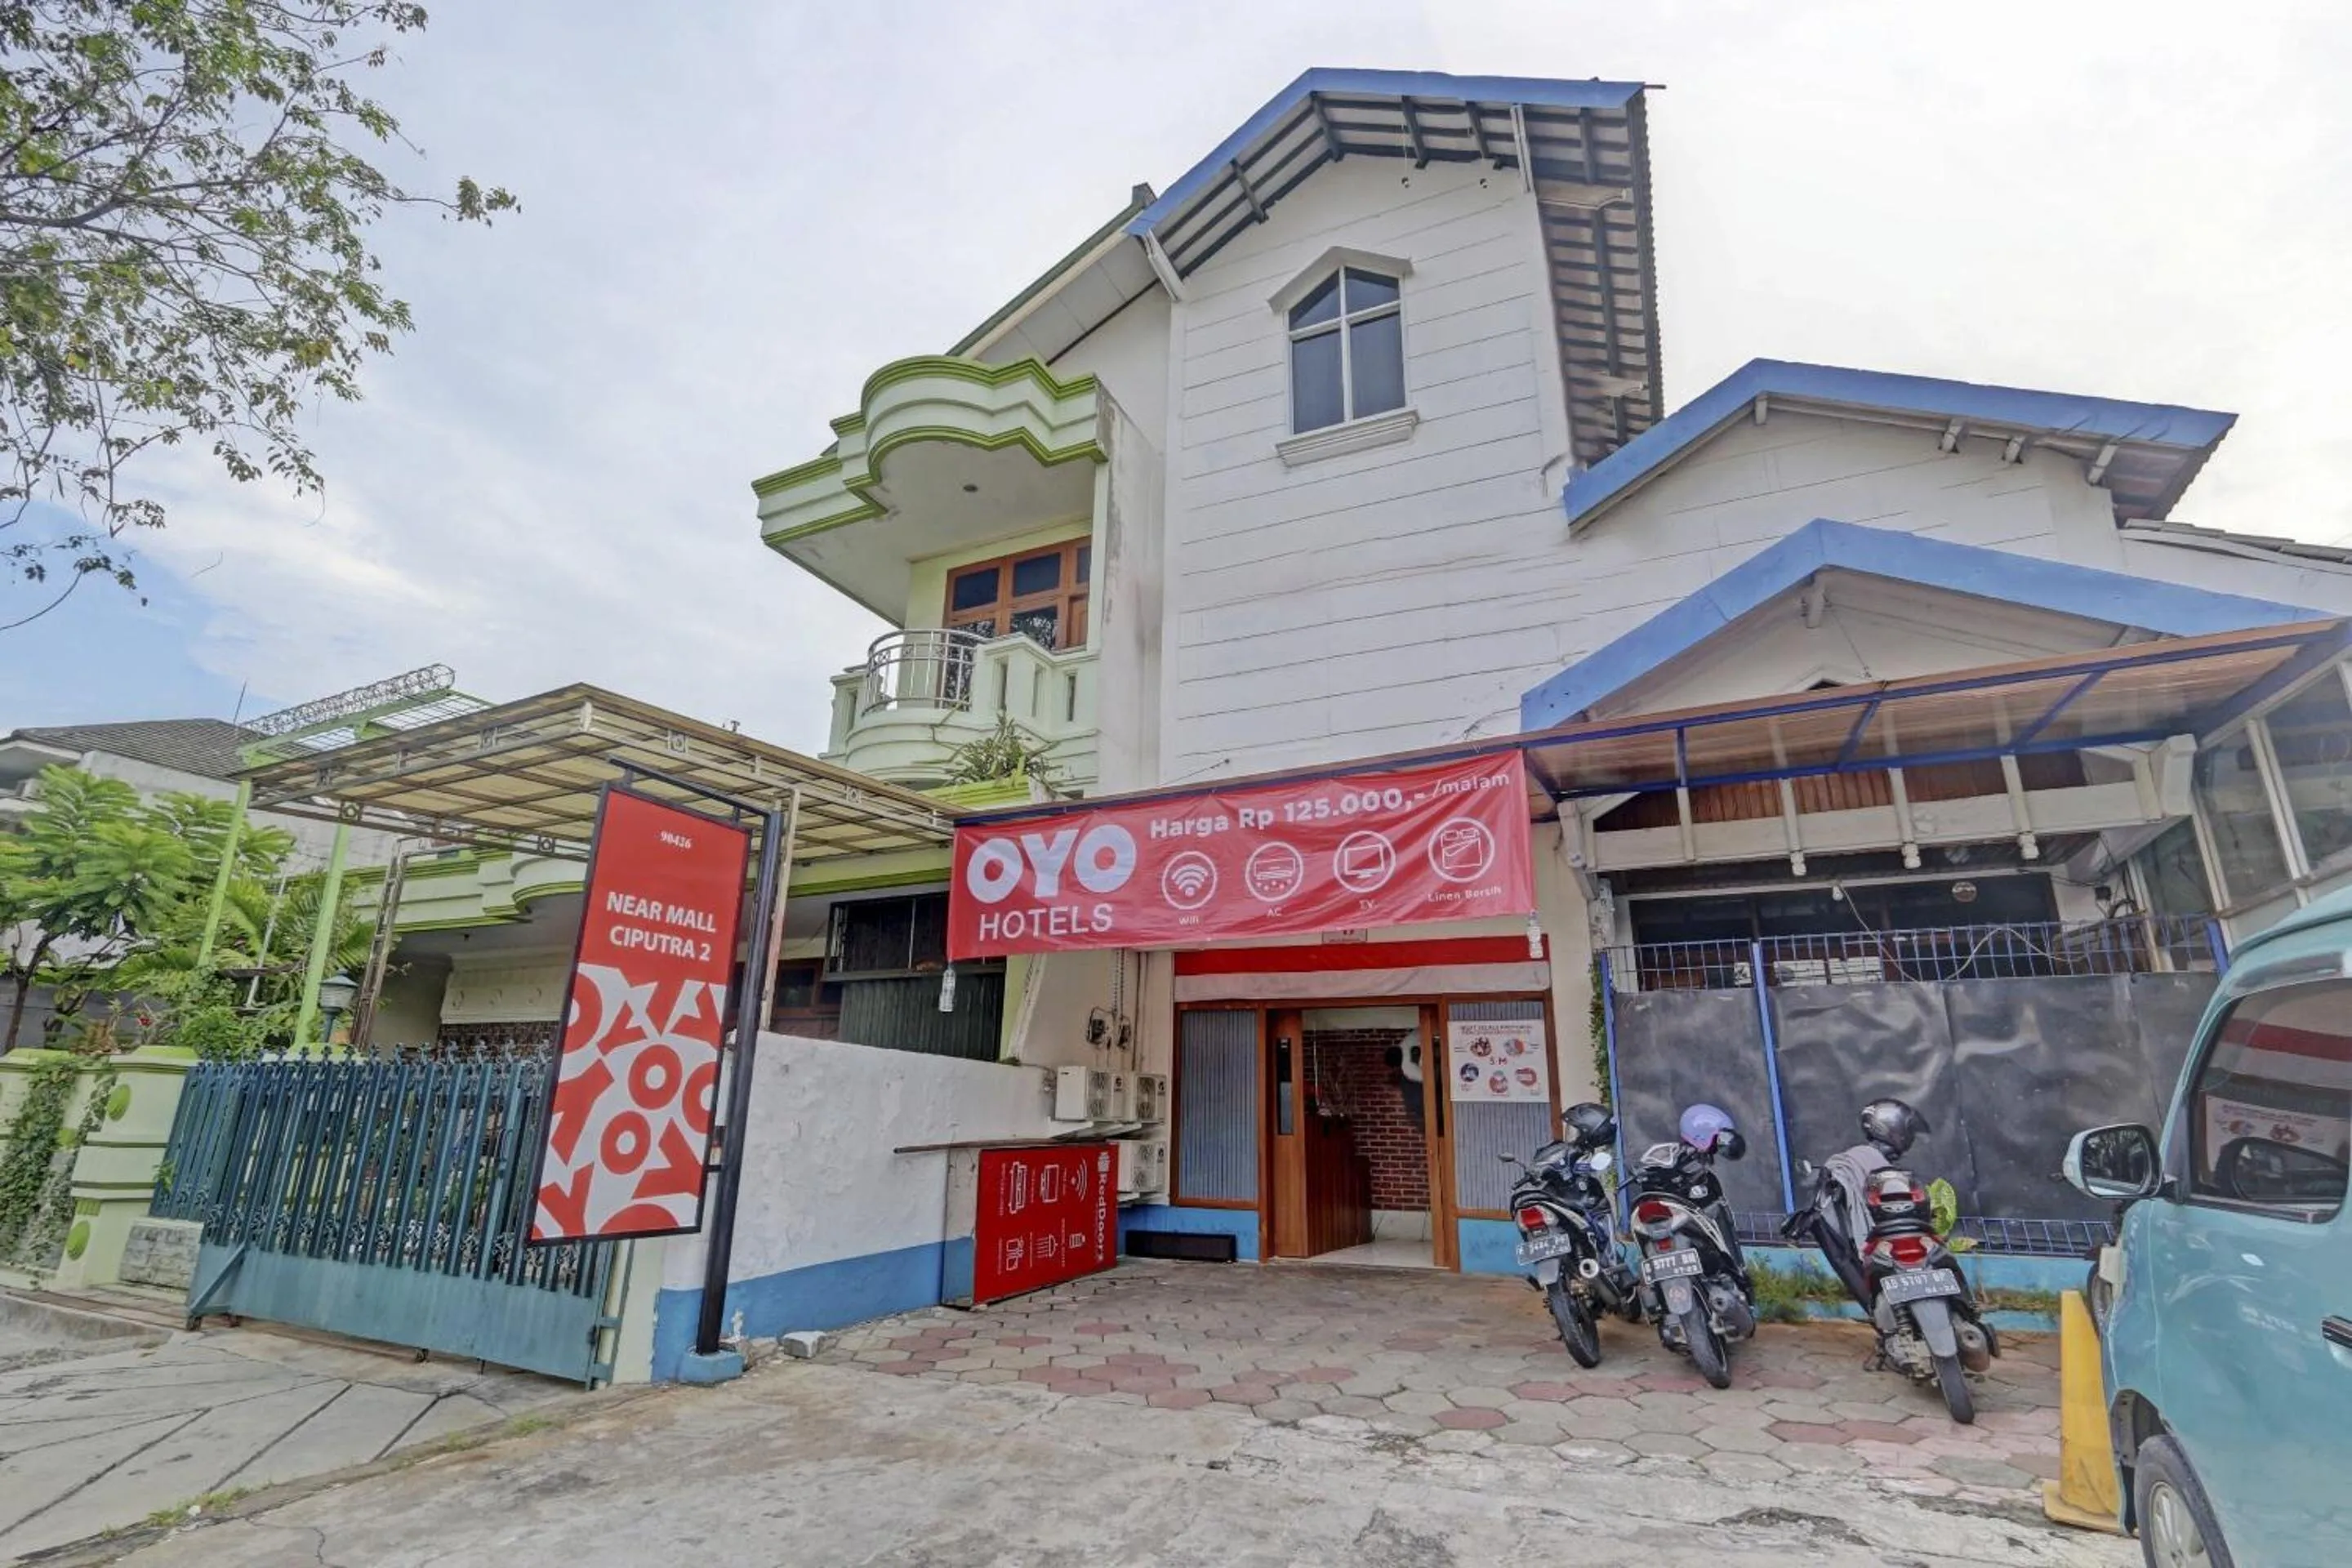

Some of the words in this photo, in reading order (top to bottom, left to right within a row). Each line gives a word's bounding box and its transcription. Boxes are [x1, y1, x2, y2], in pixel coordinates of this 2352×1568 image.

[1150, 814, 1229, 839] Harga
[1238, 808, 1274, 831] Rp
[1432, 773, 1509, 798] /malam
[967, 824, 1137, 903] OYO
[607, 891, 663, 921] NEAR
[666, 904, 716, 933] MALL
[979, 902, 1113, 941] HOTELS
[1267, 906, 1283, 917] AC
[609, 924, 695, 959] CIPUTRA
[698, 942, 712, 962] 2
